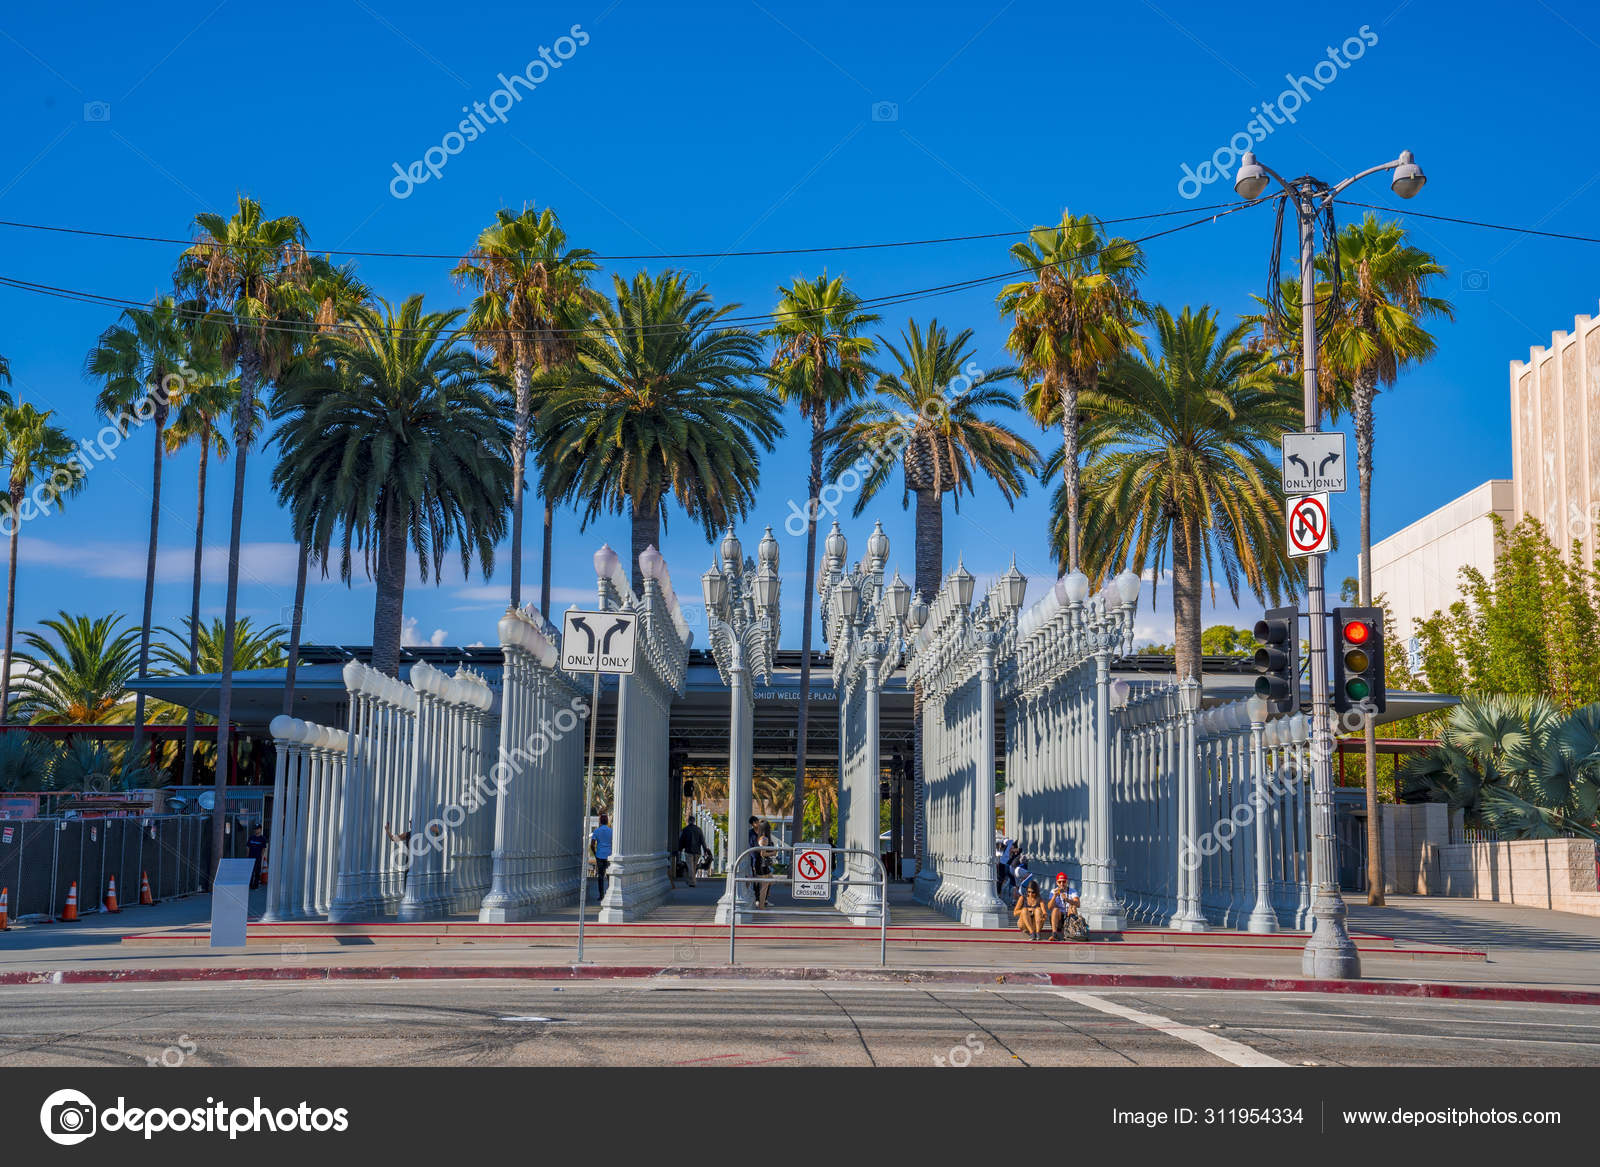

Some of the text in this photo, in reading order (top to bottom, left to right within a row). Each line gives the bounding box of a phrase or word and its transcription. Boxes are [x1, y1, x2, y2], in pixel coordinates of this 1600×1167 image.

[1286, 478, 1343, 488] ONLY ONLY
[567, 655, 629, 666] ONLY ONLY
[814, 692, 836, 700] PLAZA
